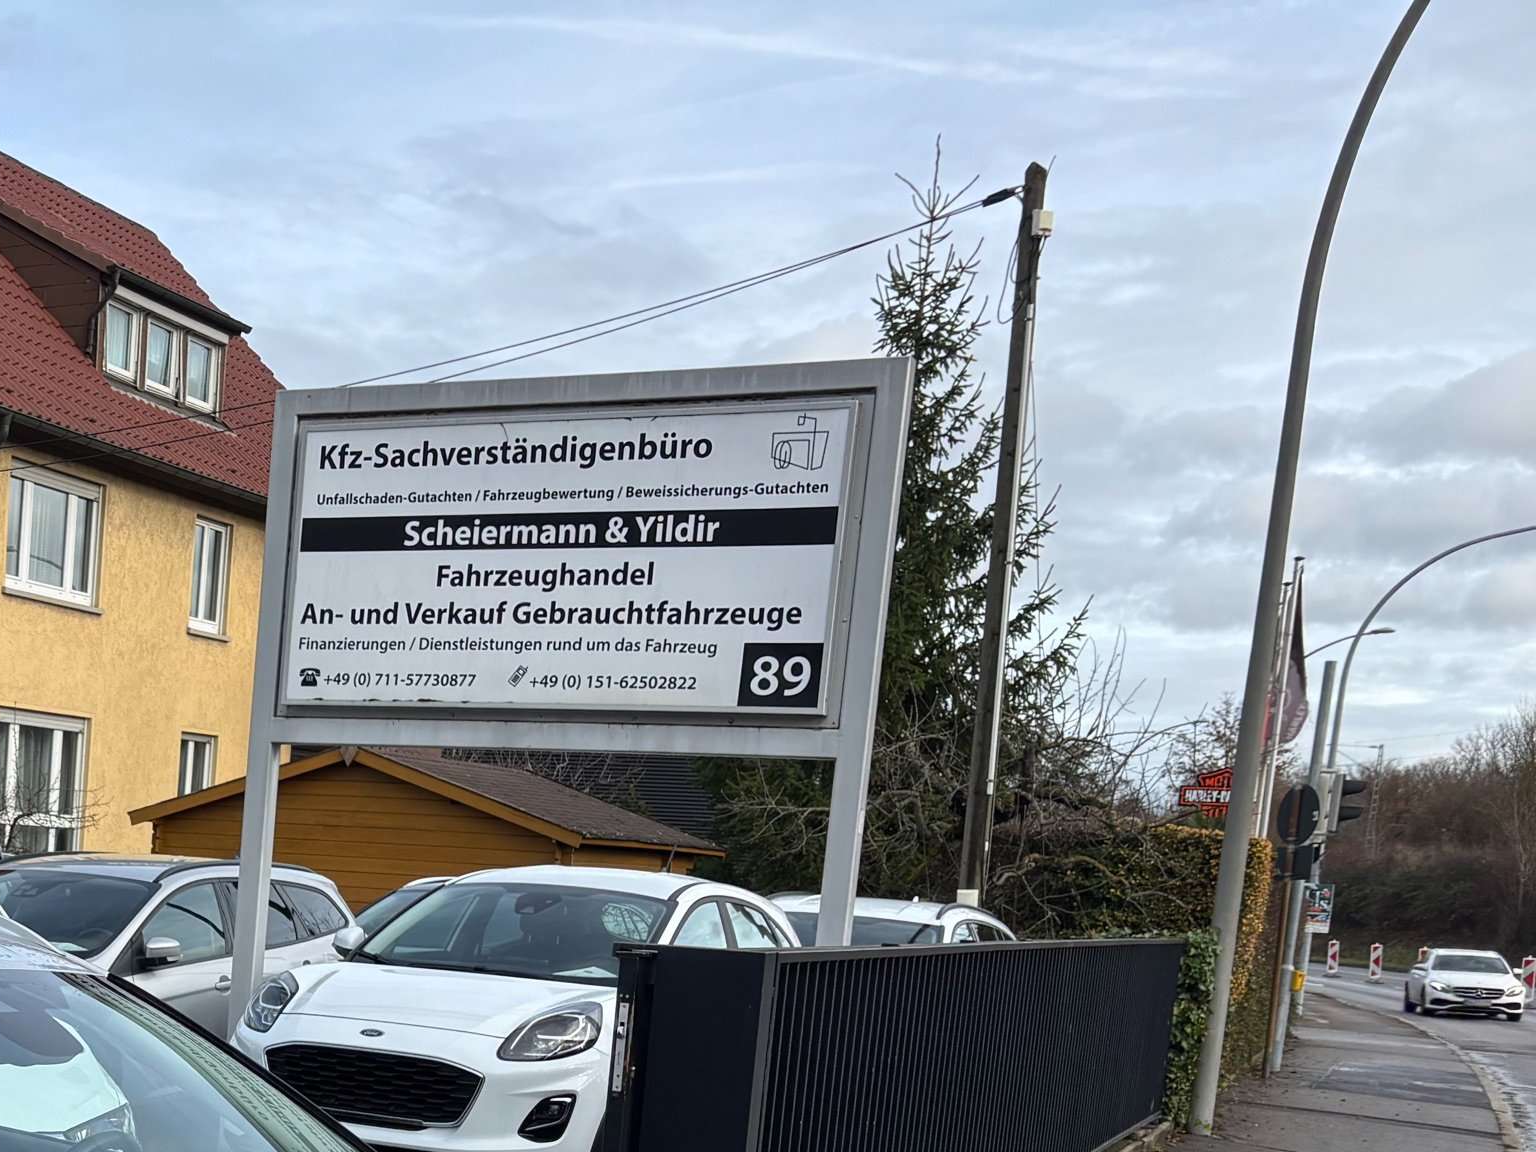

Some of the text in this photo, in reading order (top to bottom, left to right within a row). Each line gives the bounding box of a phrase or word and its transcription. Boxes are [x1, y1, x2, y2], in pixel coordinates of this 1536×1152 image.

[319, 432, 713, 470] Kfz-Sachverständigenbüro
[316, 481, 829, 506] Unfallschaden-Gutachten / Fahrzeugbewertung / Beweissicherungs-Gutachten
[403, 513, 720, 547] Scheiermann & Yildir
[436, 561, 655, 592] Fahrzeughandel
[300, 600, 803, 632] An- und Verkauf Gebrauchtfahrzeuge
[298, 636, 718, 658] Finanzierungen / Dienstleistungen rund um das Fahrzeug
[323, 672, 477, 688] +49 (0) 711-57730877
[529, 674, 697, 690] +49 (0) 151-62502822
[749, 655, 812, 697] 89
